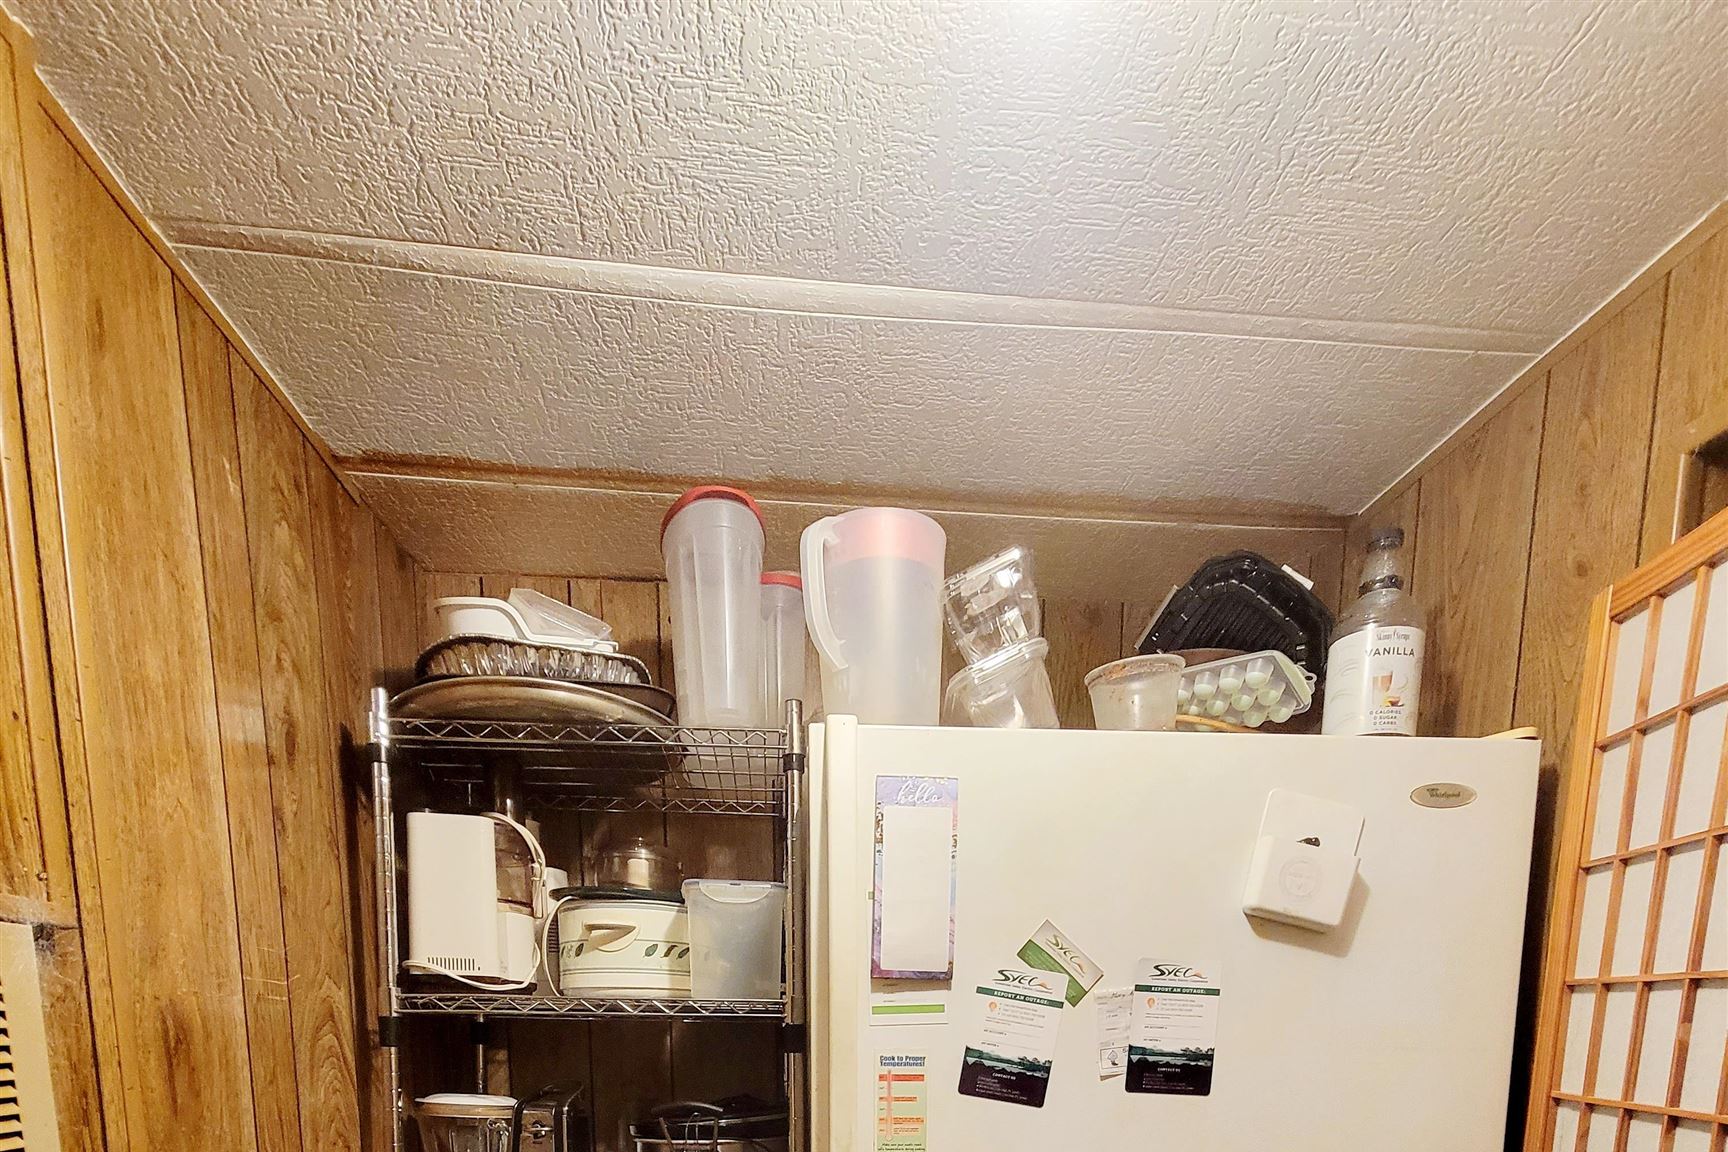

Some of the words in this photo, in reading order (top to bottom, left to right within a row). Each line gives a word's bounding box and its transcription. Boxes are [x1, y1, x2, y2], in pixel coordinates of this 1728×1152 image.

[1365, 646, 1415, 657] VANILLA
[896, 780, 944, 804] hello
[993, 990, 1015, 1000] REPORT
[904, 1055, 926, 1063] Proper
